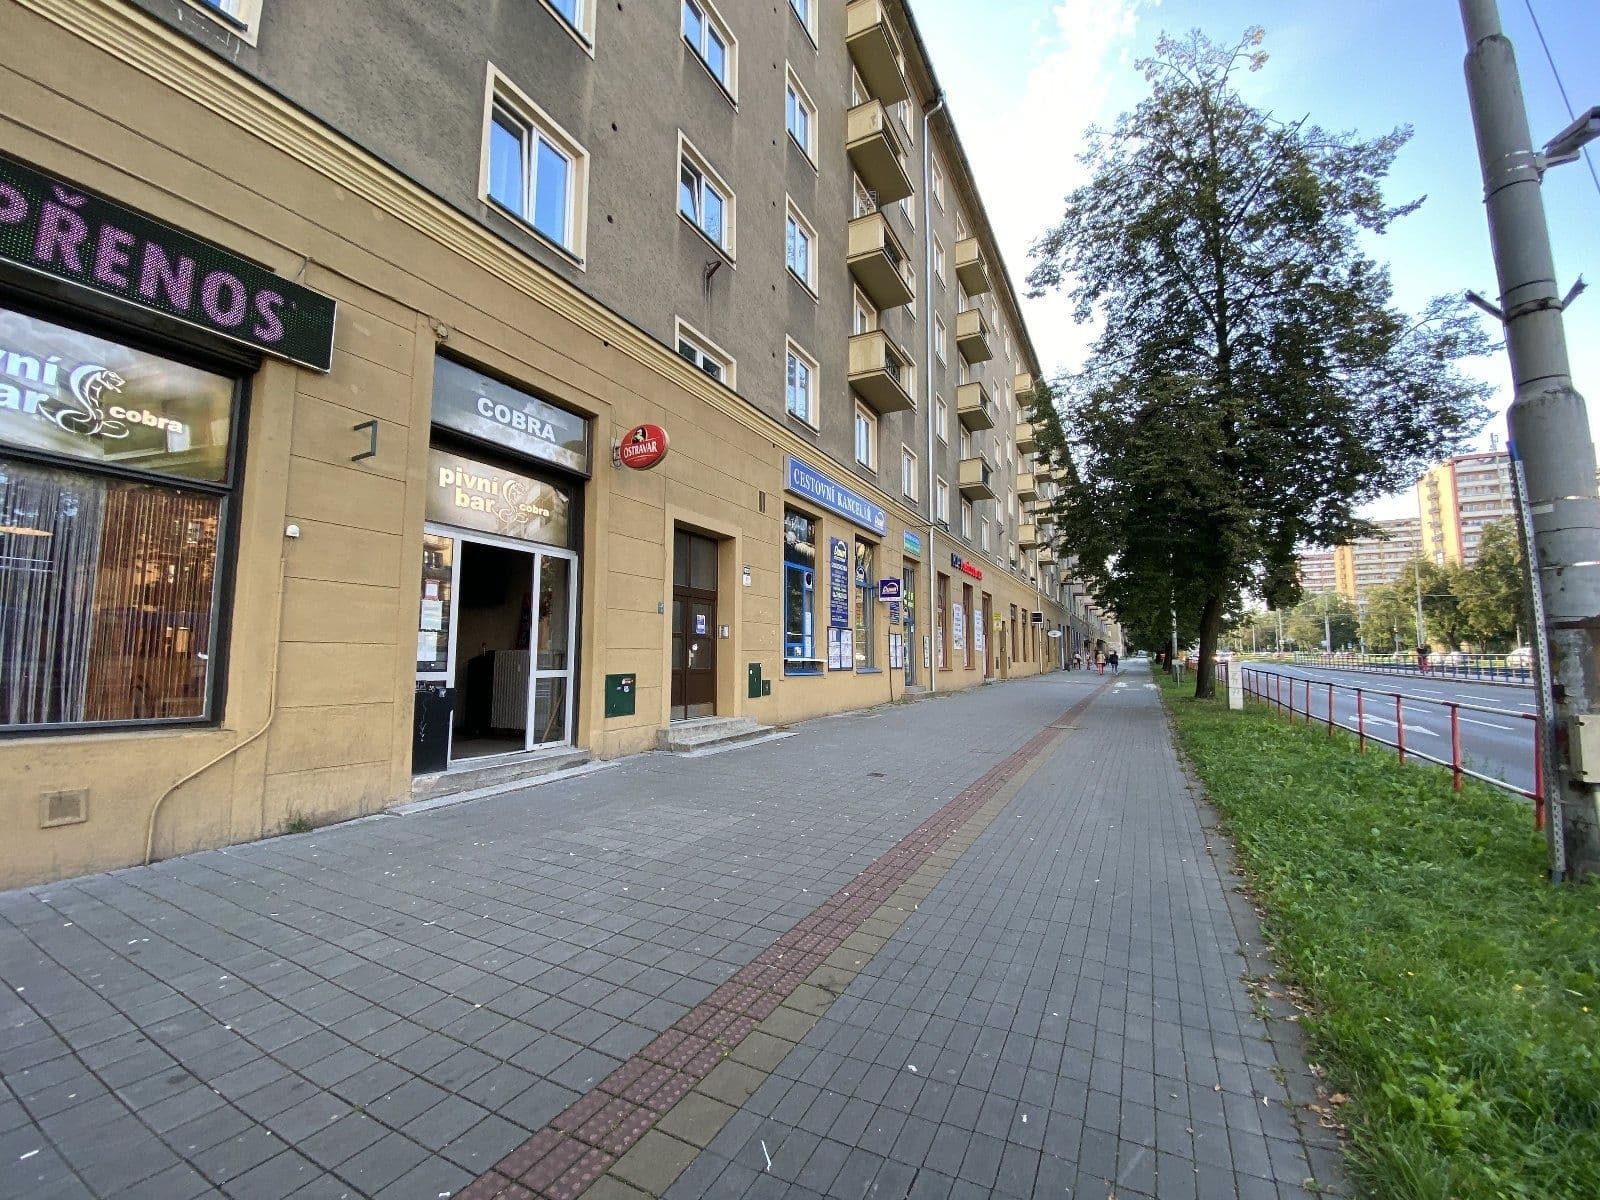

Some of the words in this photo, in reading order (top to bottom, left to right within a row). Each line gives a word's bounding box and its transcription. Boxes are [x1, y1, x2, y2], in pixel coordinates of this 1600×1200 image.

[109, 404, 183, 434] cobra
[477, 397, 556, 443] COBRA
[623, 440, 658, 459] OSTRAVAR
[455, 486, 496, 513] bar
[793, 468, 835, 503] CESTOVNÍ
[519, 503, 550, 517] cobra
